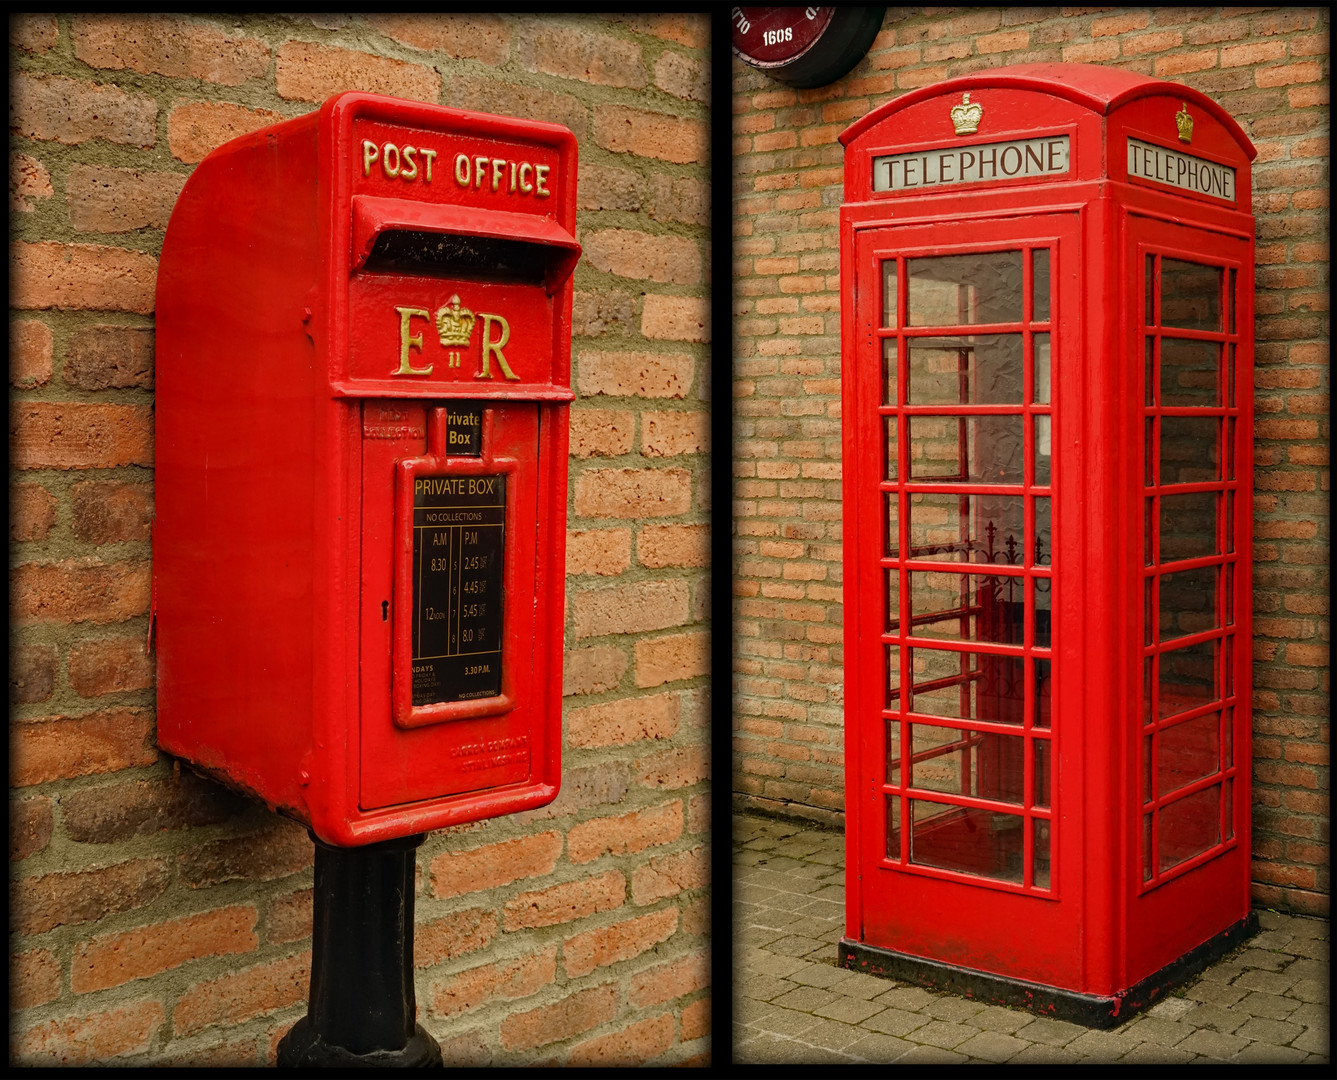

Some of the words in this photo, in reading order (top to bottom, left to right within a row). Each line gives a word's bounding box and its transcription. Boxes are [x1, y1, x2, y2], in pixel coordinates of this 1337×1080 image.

[763, 27, 793, 47] 1608
[362, 140, 437, 182] POST
[454, 154, 551, 196] OFFICE
[882, 140, 1065, 189] TELEPHONE
[1129, 143, 1232, 199] TELEPHONE
[447, 411, 480, 426] rivate
[449, 430, 471, 445] Box
[415, 479, 465, 496] PRIVATE
[468, 479, 495, 495] BOX
[426, 513, 438, 522] NO
[438, 512, 483, 522] COLLECTIONS
[431, 558, 447, 572] 8.30
[464, 556, 479, 570] 2.45
[463, 581, 479, 594] 4.45
[463, 604, 478, 618] 5.45
[462, 629, 474, 642] 8.0
[412, 665, 434, 673] NDAYS
[464, 666, 478, 676] 3.30
